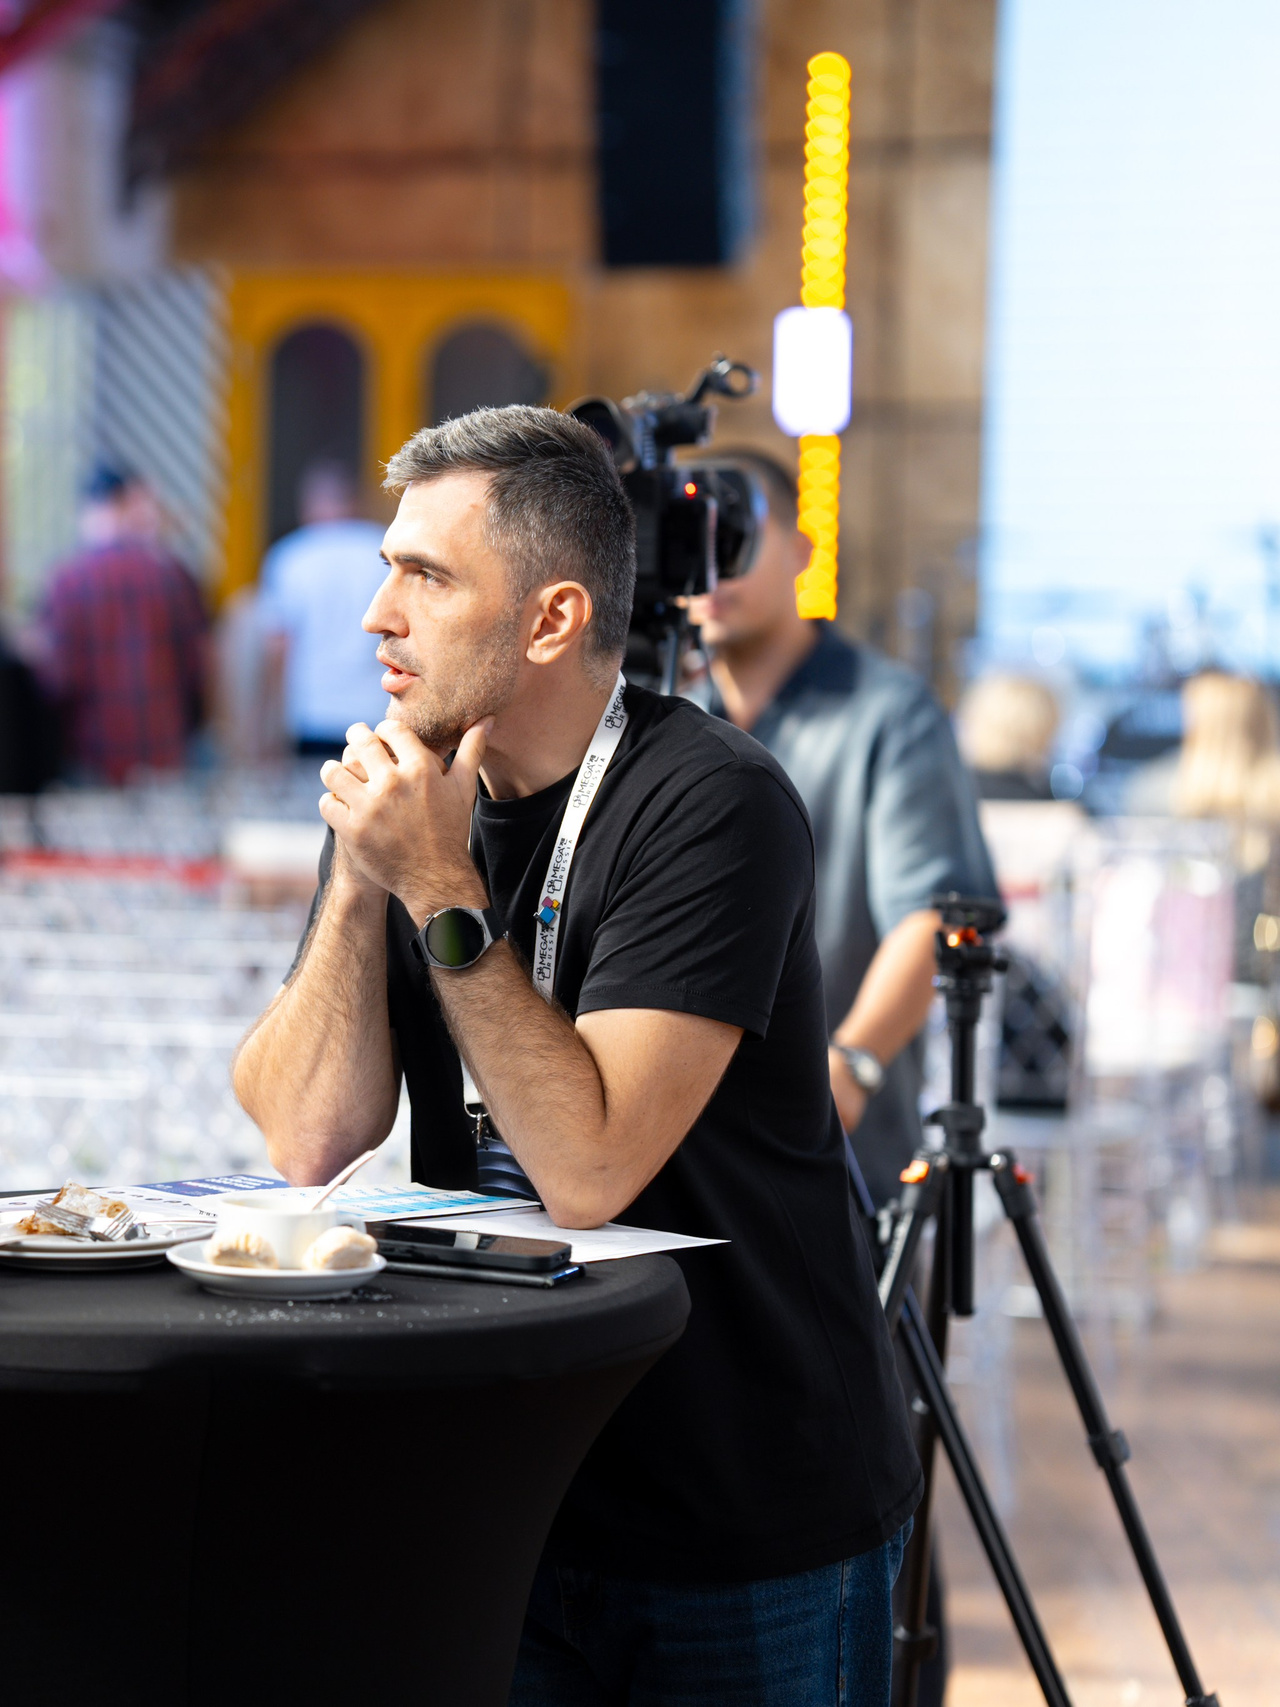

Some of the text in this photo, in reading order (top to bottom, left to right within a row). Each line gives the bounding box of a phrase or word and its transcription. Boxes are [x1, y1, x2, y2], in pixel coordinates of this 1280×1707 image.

[586, 756, 605, 795] RUSSIA
[558, 838, 573, 880] RUSSIA
[547, 926, 555, 967] RUSSIA
